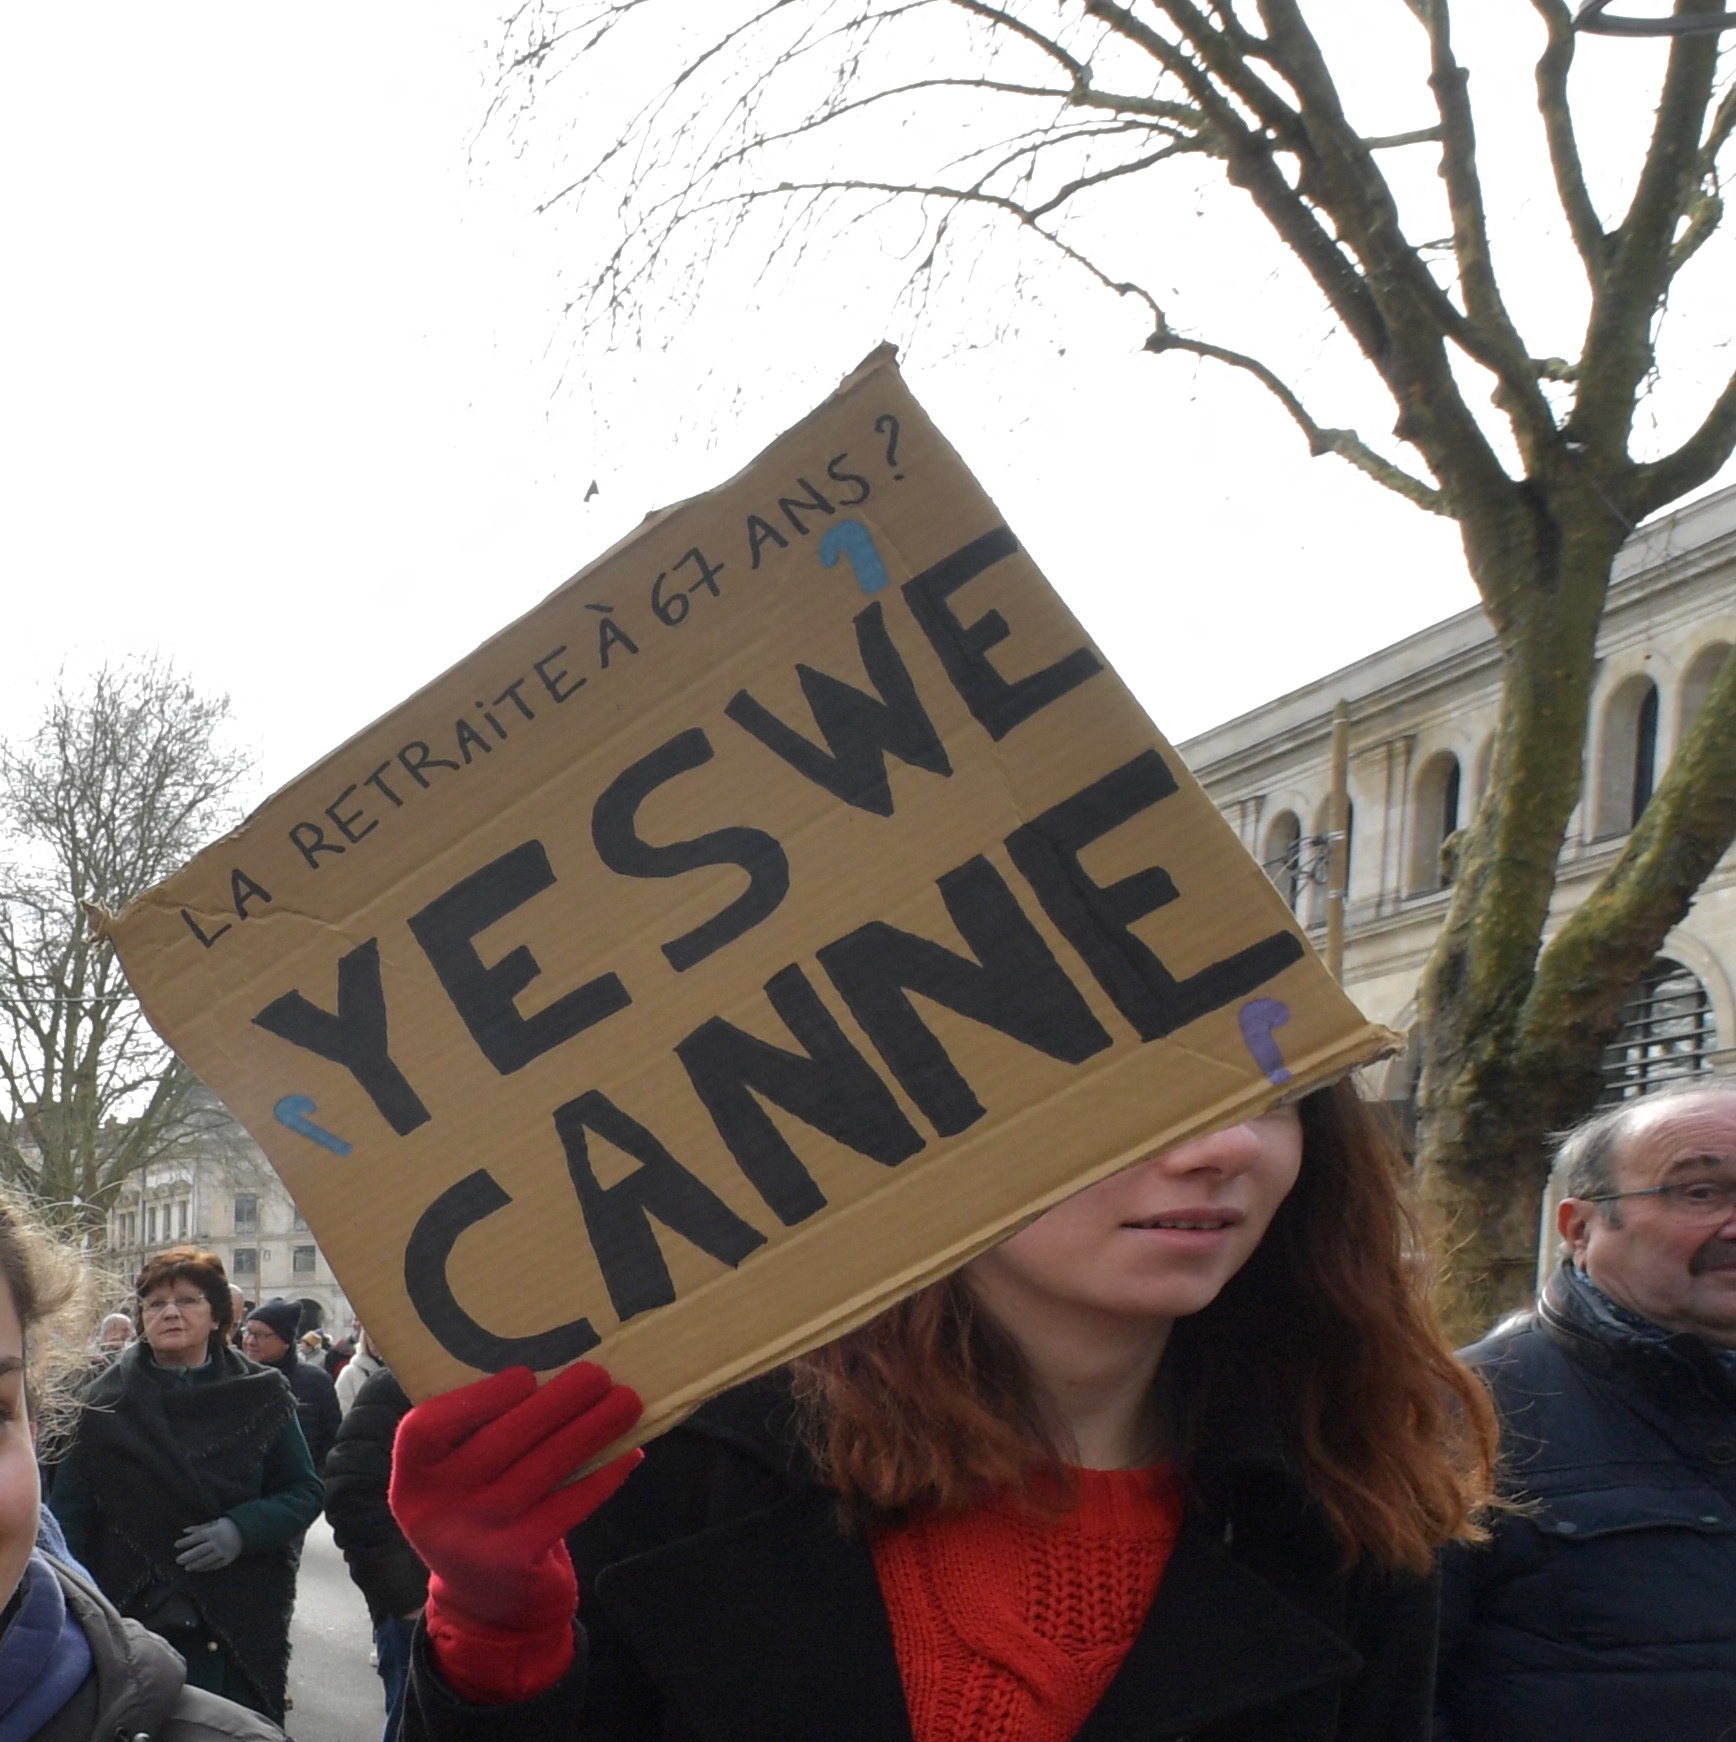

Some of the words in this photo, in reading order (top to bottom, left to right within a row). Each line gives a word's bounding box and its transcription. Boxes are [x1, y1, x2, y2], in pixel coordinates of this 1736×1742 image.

[180, 868, 273, 949] LA
[584, 603, 640, 669] À
[651, 546, 726, 627] 67
[404, 749, 1304, 1372] CANNE
